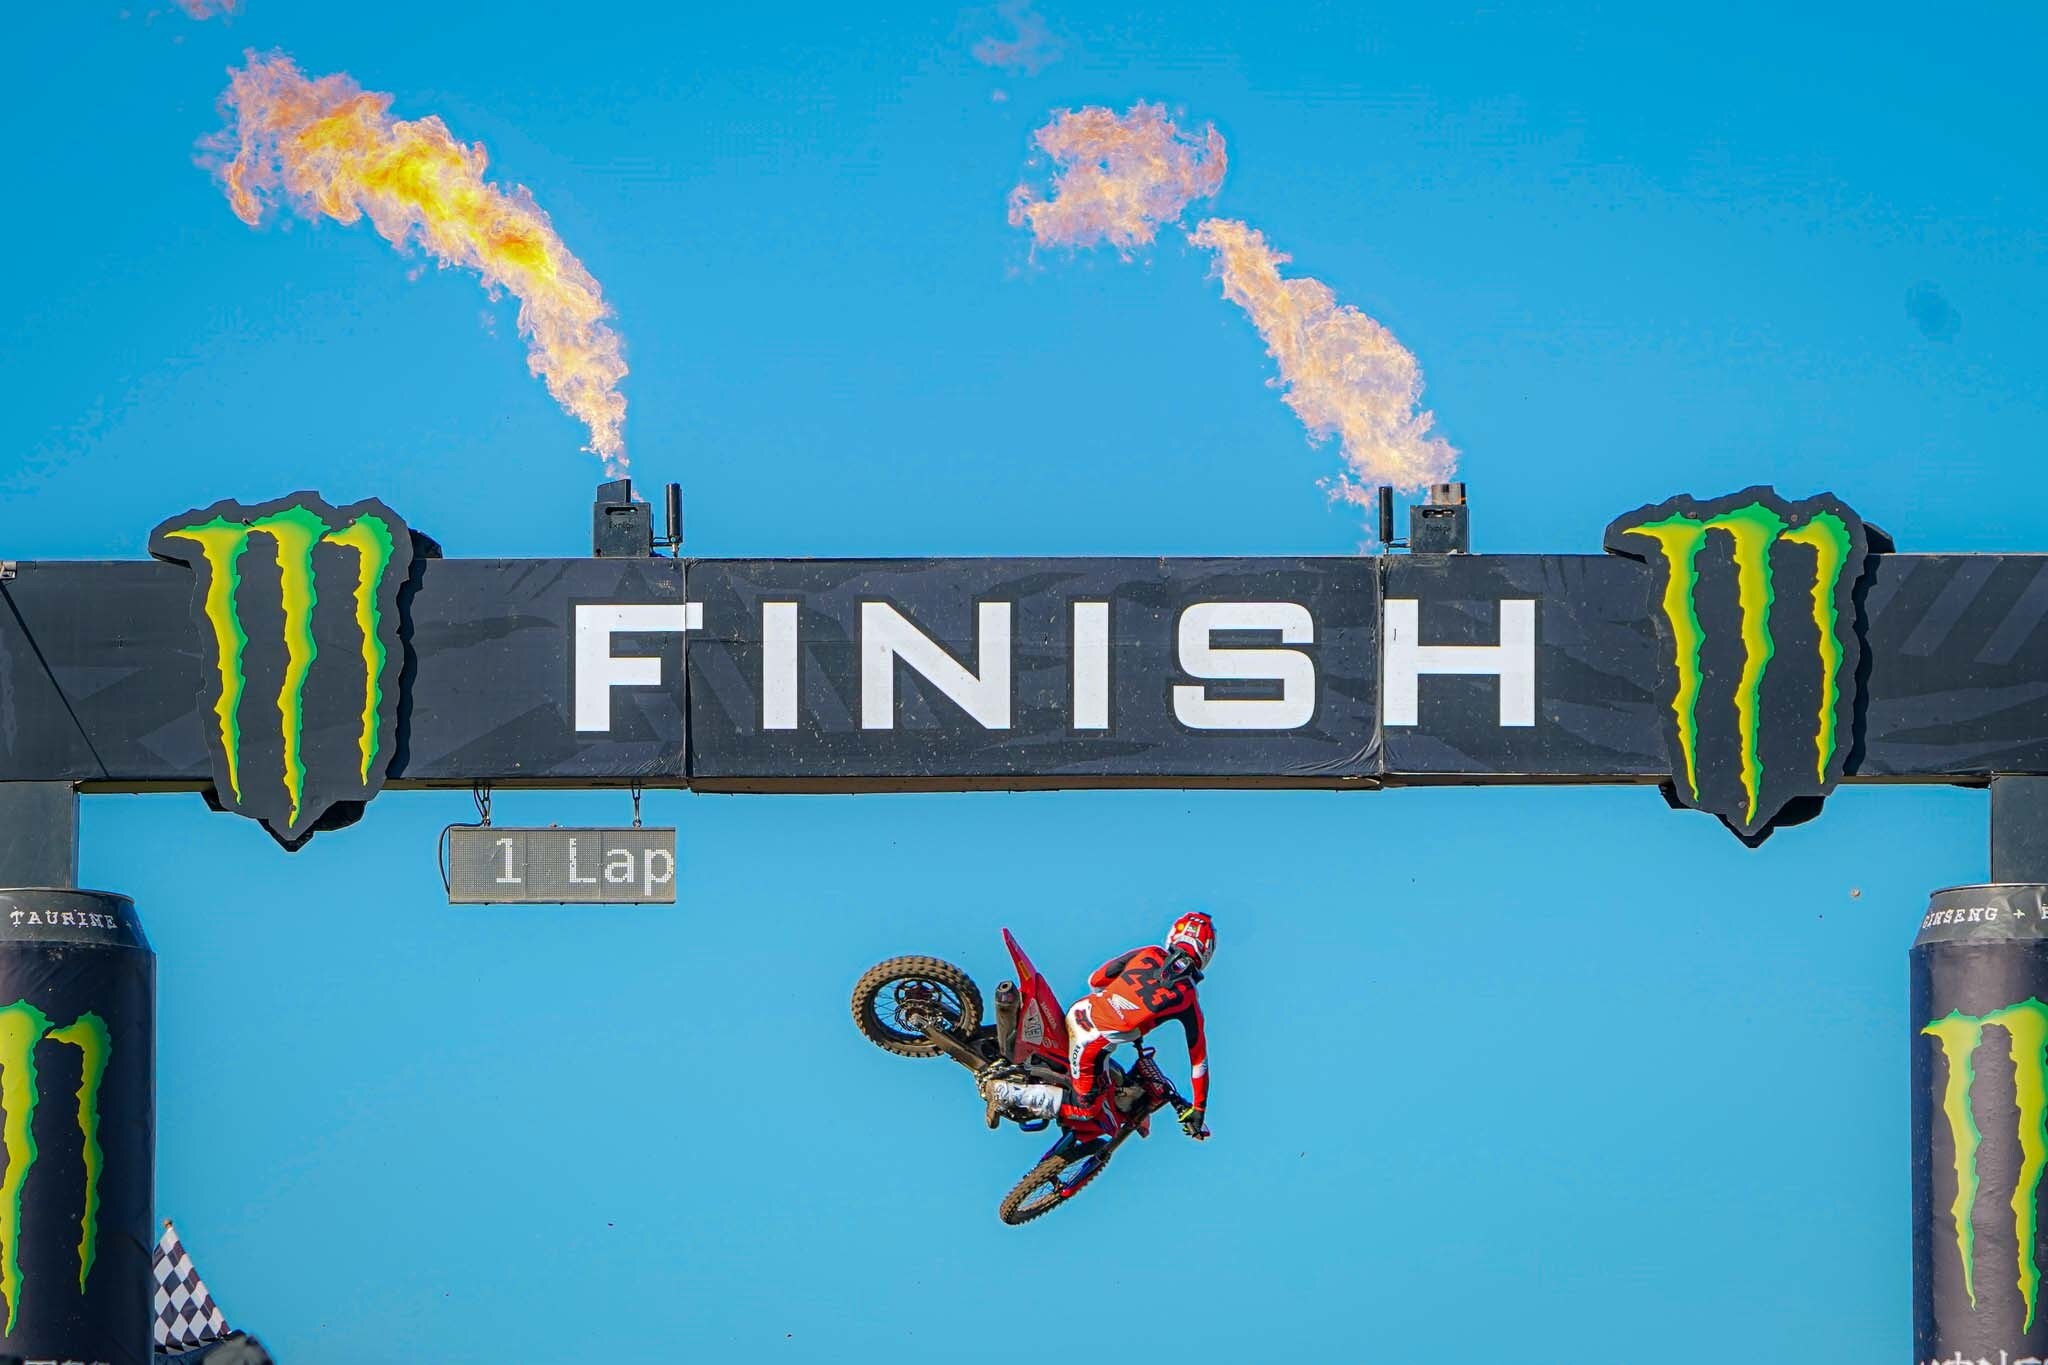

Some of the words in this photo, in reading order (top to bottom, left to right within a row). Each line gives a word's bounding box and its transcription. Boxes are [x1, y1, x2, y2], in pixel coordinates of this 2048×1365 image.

[574, 599, 1536, 733] FINISH
[496, 838, 522, 884] 1
[569, 838, 675, 897] Lap
[9, 905, 118, 930] TAURINE
[1922, 907, 1999, 929] GINSENG
[1121, 957, 1187, 1014] 243
